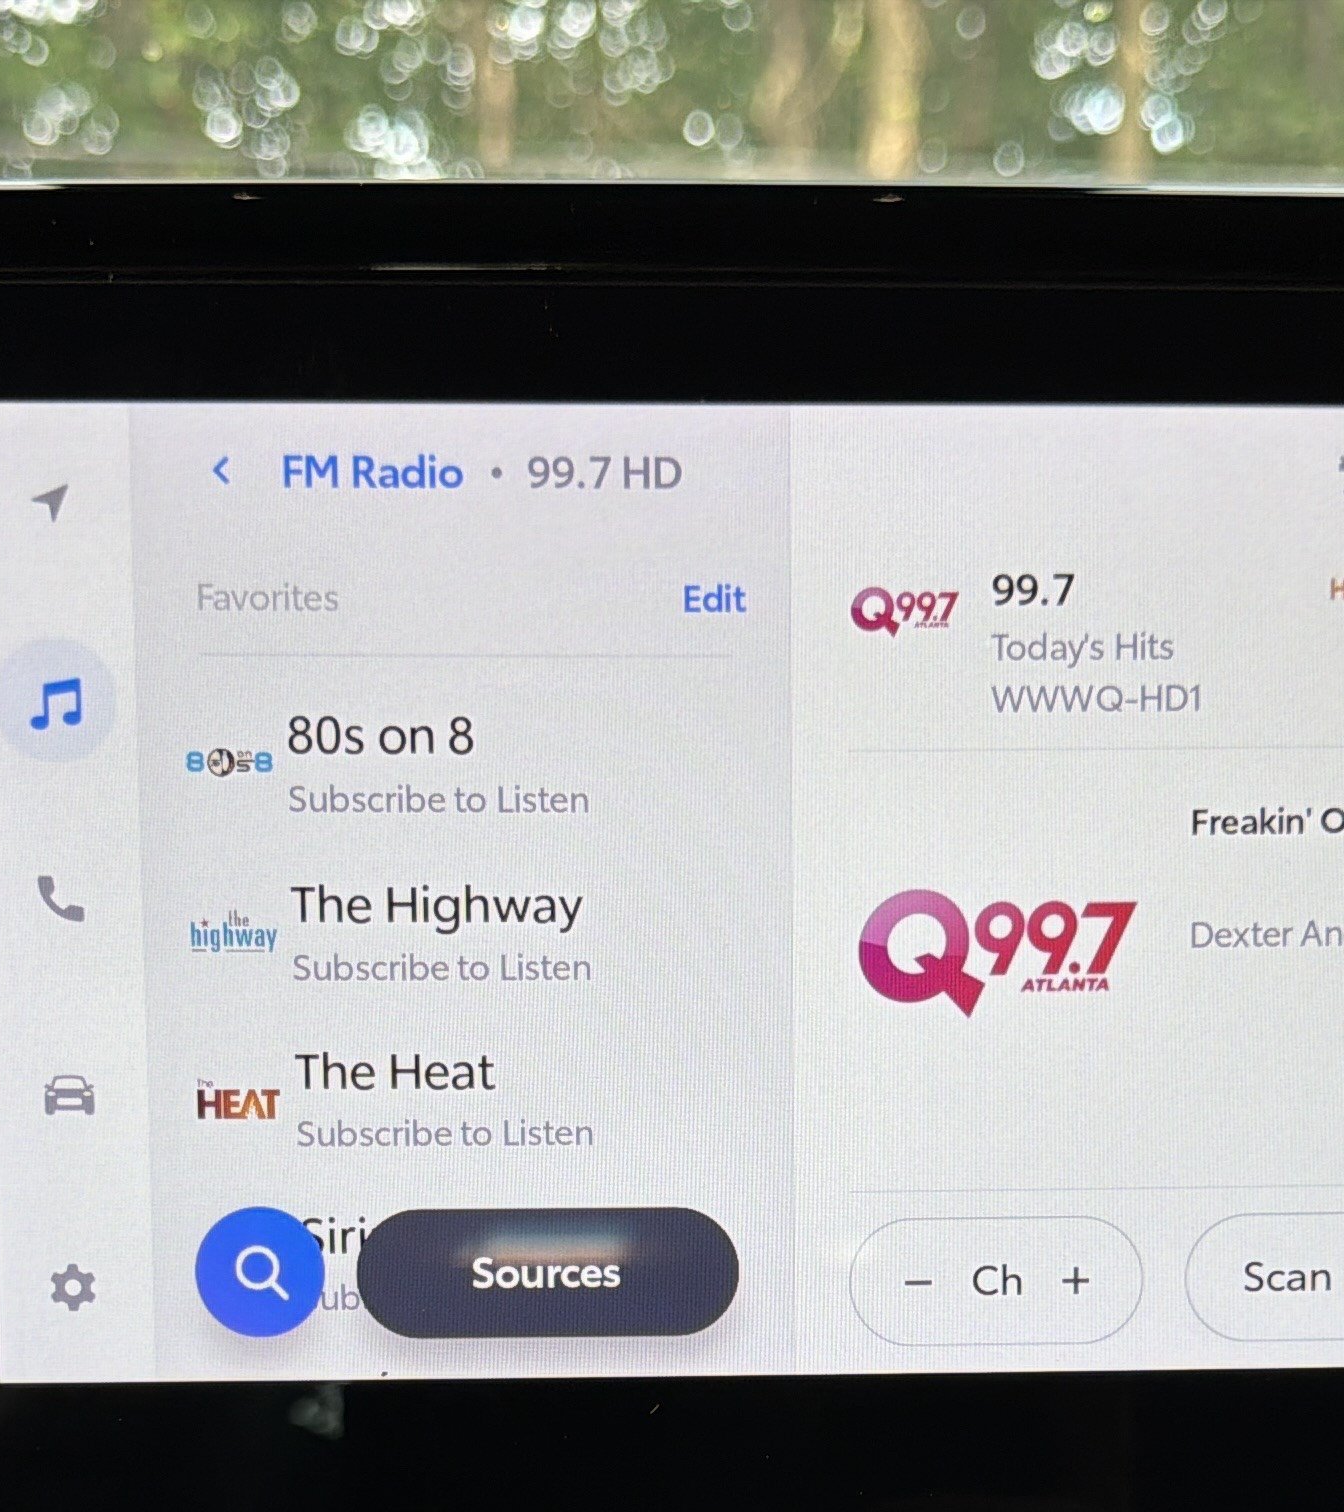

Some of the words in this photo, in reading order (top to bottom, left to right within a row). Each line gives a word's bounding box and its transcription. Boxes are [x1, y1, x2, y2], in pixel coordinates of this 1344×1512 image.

[282, 455, 339, 489] FM
[352, 454, 463, 490] Radio
[528, 456, 611, 489] 99.7
[623, 456, 682, 489] HD
[197, 583, 339, 612] Favorites
[684, 585, 746, 613] Edit
[993, 574, 1074, 605] 99.7
[991, 633, 1103, 666] Today's
[1116, 632, 1173, 660] Hits
[991, 685, 1201, 713] WWWQ-HD1
[288, 716, 364, 755] 80s
[379, 726, 434, 755] on
[449, 716, 473, 755] 8
[289, 785, 446, 813] Subscribe
[454, 788, 486, 813] to
[498, 786, 589, 813] Listen
[1191, 807, 1312, 835] Freakin'
[228, 909, 250, 927] the
[291, 885, 371, 924] The
[387, 885, 583, 934] Highway
[190, 920, 277, 952] highway
[1190, 921, 1293, 948] Dexter
[293, 953, 450, 981] Subscribe
[457, 957, 490, 981] to
[501, 954, 591, 981] Listen
[1020, 977, 1110, 993] ATLANTA
[295, 1053, 375, 1090] The
[391, 1054, 495, 1090] Heat
[197, 1088, 280, 1119] HEAT
[297, 1119, 453, 1147] Subscribe
[460, 1122, 492, 1147] to
[503, 1120, 593, 1147] Listen
[471, 1257, 622, 1289] Sources
[972, 1264, 1023, 1296] Ch
[1243, 1261, 1332, 1292] Scan
